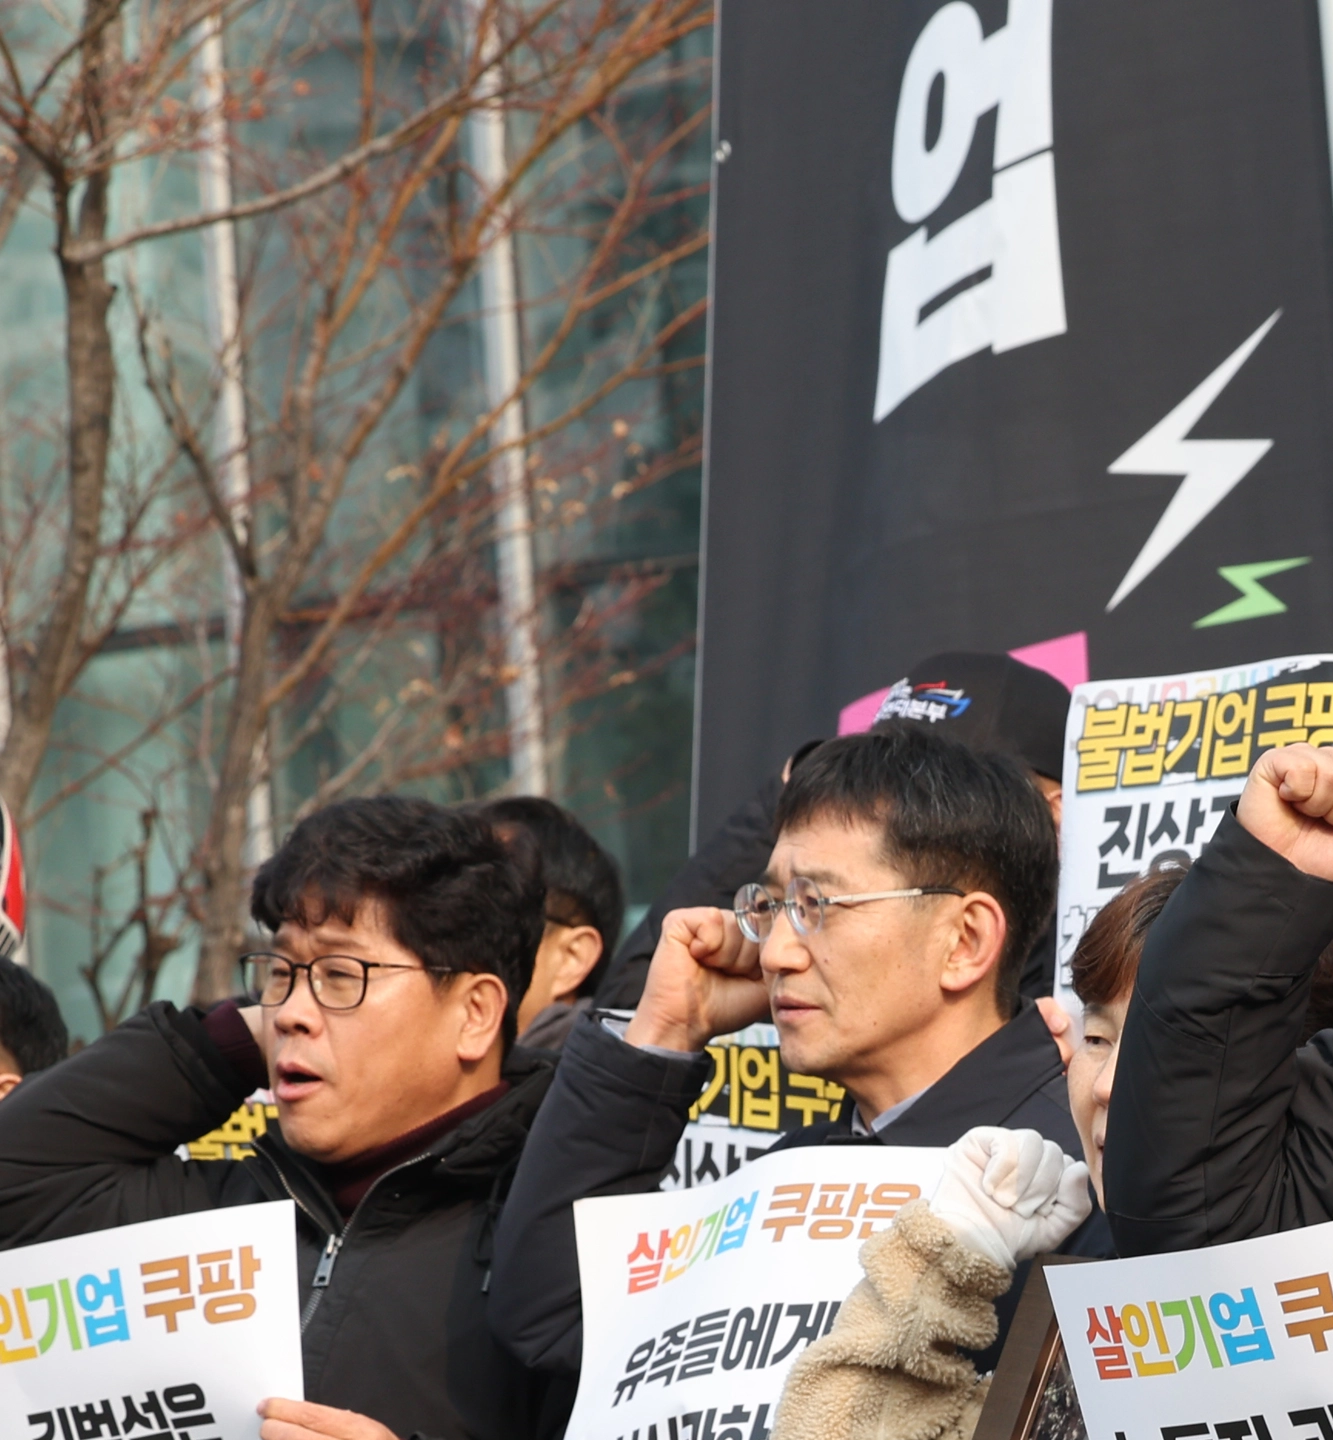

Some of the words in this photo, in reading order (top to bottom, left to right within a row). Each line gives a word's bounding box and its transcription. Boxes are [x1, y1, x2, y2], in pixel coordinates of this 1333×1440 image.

[1076, 688, 1258, 794] 불법기업
[1097, 795, 1242, 890] 진상
[688, 1045, 780, 1130] 기업
[627, 1190, 760, 1295] 살인기업
[761, 1183, 922, 1243] 쿠팡은
[140, 1245, 261, 1334] 쿠팡
[1086, 1286, 1276, 1381] 살인기업
[611, 1300, 843, 1408] 유족들에게
